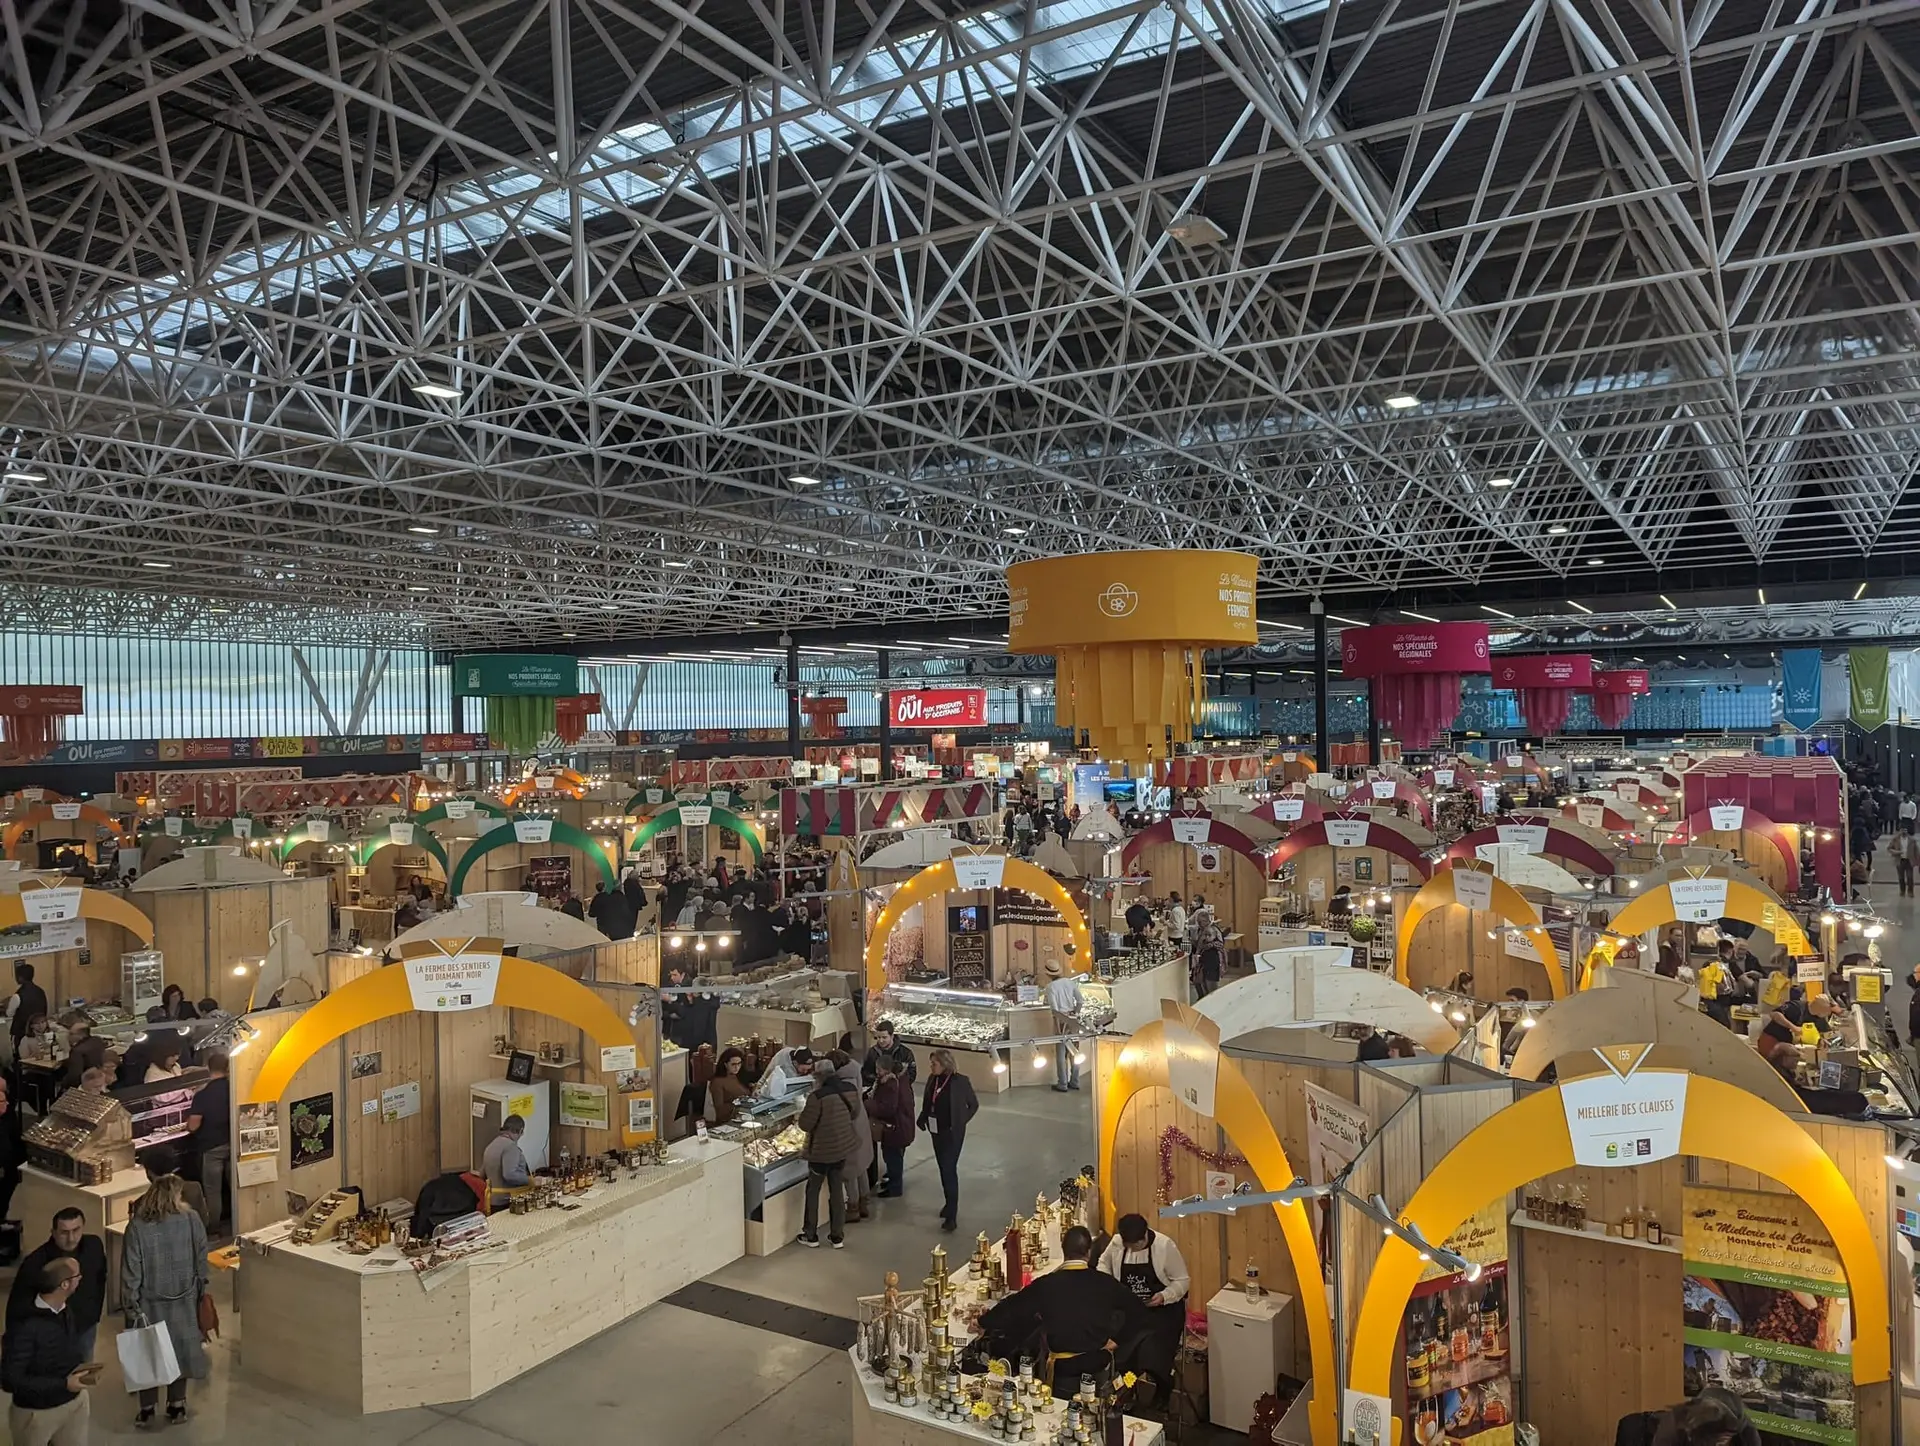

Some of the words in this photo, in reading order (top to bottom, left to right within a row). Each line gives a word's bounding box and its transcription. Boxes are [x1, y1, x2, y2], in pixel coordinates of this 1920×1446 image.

[1219, 589, 1232, 602] NOS
[1393, 643, 1404, 651] NOS
[1405, 641, 1438, 650] SPÉCIALITÉS
[1399, 649, 1432, 658] RÉGIONALES
[898, 699, 922, 722] OUI
[923, 706, 935, 714] AUX
[936, 700, 963, 711] PRODUITS
[68, 743, 92, 761] OUI
[343, 738, 361, 753] OUI
[415, 965, 423, 974] LA
[425, 964, 446, 973] FERME
[448, 963, 459, 972] DES
[461, 961, 491, 971] SENTIERS
[424, 973, 433, 981] DU
[435, 972, 465, 981] DIAMANT
[466, 970, 482, 979] NOIR
[1617, 1050, 1630, 1061] 155
[1317, 1101, 1325, 1111] LA
[1326, 1104, 1347, 1122] FERME
[1348, 1116, 1358, 1128] DU
[1577, 1104, 1619, 1120] MIELLERIE
[1621, 1102, 1636, 1116] DES
[1639, 1099, 1675, 1114] CLAUSES
[1737, 1209, 1787, 1226] Bienvenue
[1793, 1216, 1801, 1227] à
[1456, 1232, 1467, 1243] des
[1470, 1226, 1496, 1241] Clauses
[1703, 1222, 1713, 1232] la
[1716, 1222, 1766, 1239] Miellerie
[1769, 1231, 1786, 1241] des
[1791, 1232, 1835, 1248] Clauses
[1467, 1239, 1484, 1250] Aude
[1727, 1235, 1776, 1250] Montséret
[1786, 1243, 1813, 1255] Aude
[1699, 1247, 1721, 1259] Venez
[1745, 1254, 1785, 1268] découverte
[1788, 1261, 1801, 1271] des
[1806, 1262, 1836, 1276] abeilles
[1752, 1272, 1777, 1284] Théâtre
[1790, 1424, 1822, 1437] Miellerie
